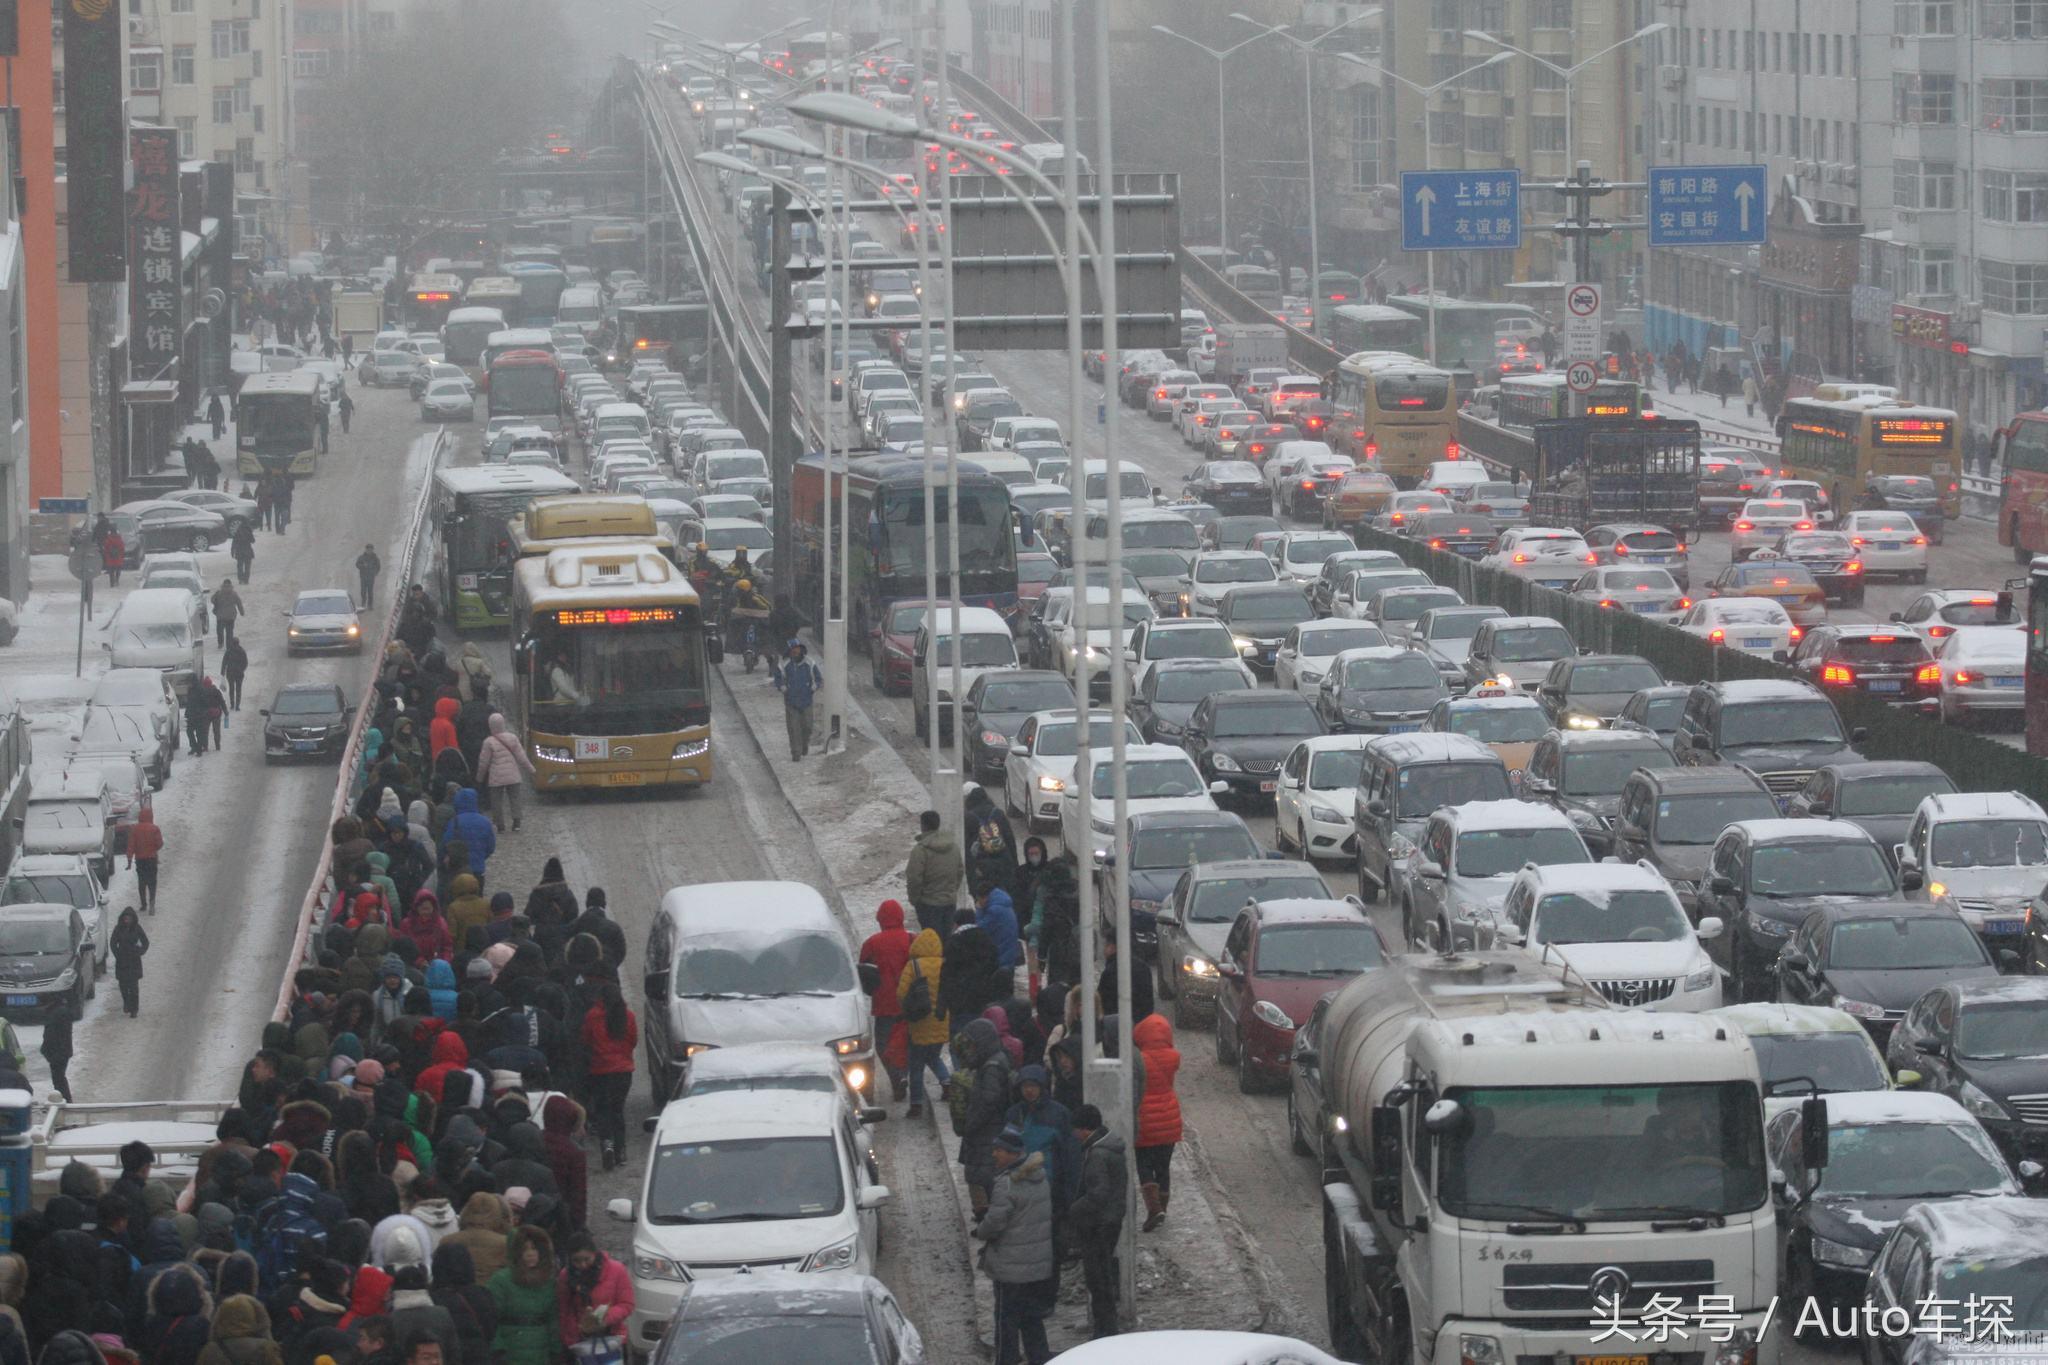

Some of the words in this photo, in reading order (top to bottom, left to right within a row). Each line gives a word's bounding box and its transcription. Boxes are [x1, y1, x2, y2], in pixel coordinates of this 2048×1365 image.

[1454, 181, 1511, 198] 上海街
[1659, 177, 1718, 194] 新阳路
[1455, 218, 1512, 234] 友谊路
[1660, 211, 1718, 227] 安国街
[1572, 370, 1589, 385] 30
[584, 743, 599, 755] 348
